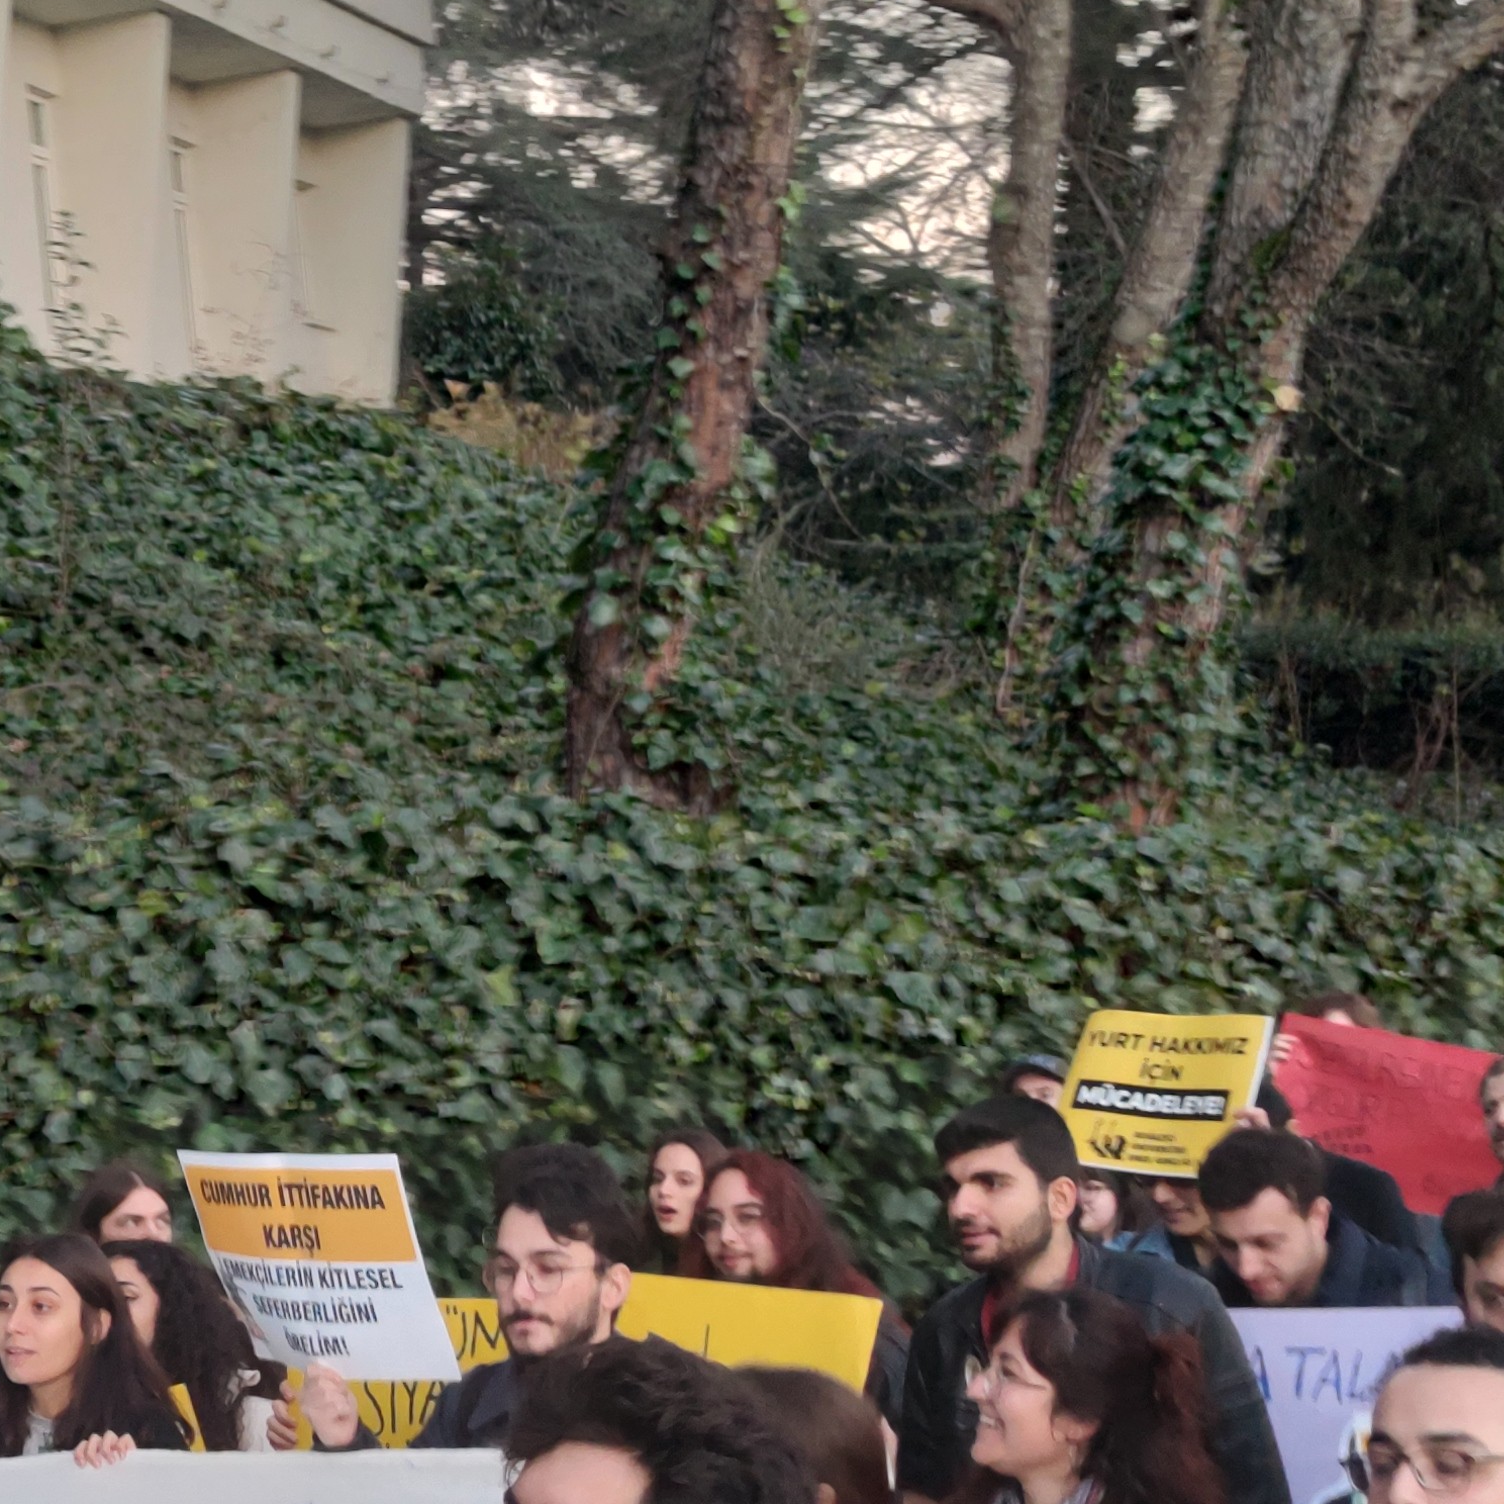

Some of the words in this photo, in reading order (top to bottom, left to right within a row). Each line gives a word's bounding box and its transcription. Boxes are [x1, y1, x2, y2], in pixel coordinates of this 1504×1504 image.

[1088, 1030, 1144, 1051] YURT
[1150, 1036, 1249, 1055] HAKKIMIZ
[199, 1178, 273, 1208] CUMHUR
[277, 1176, 386, 1210] İTTİFAKINA
[262, 1224, 321, 1258] KARŞI
[221, 1259, 314, 1290] EMEKÇİLERİN
[318, 1262, 403, 1290] KİTLESEL
[253, 1295, 378, 1325] SEFERBERLİĞİNİ
[284, 1326, 351, 1358] ÖRELİM!
